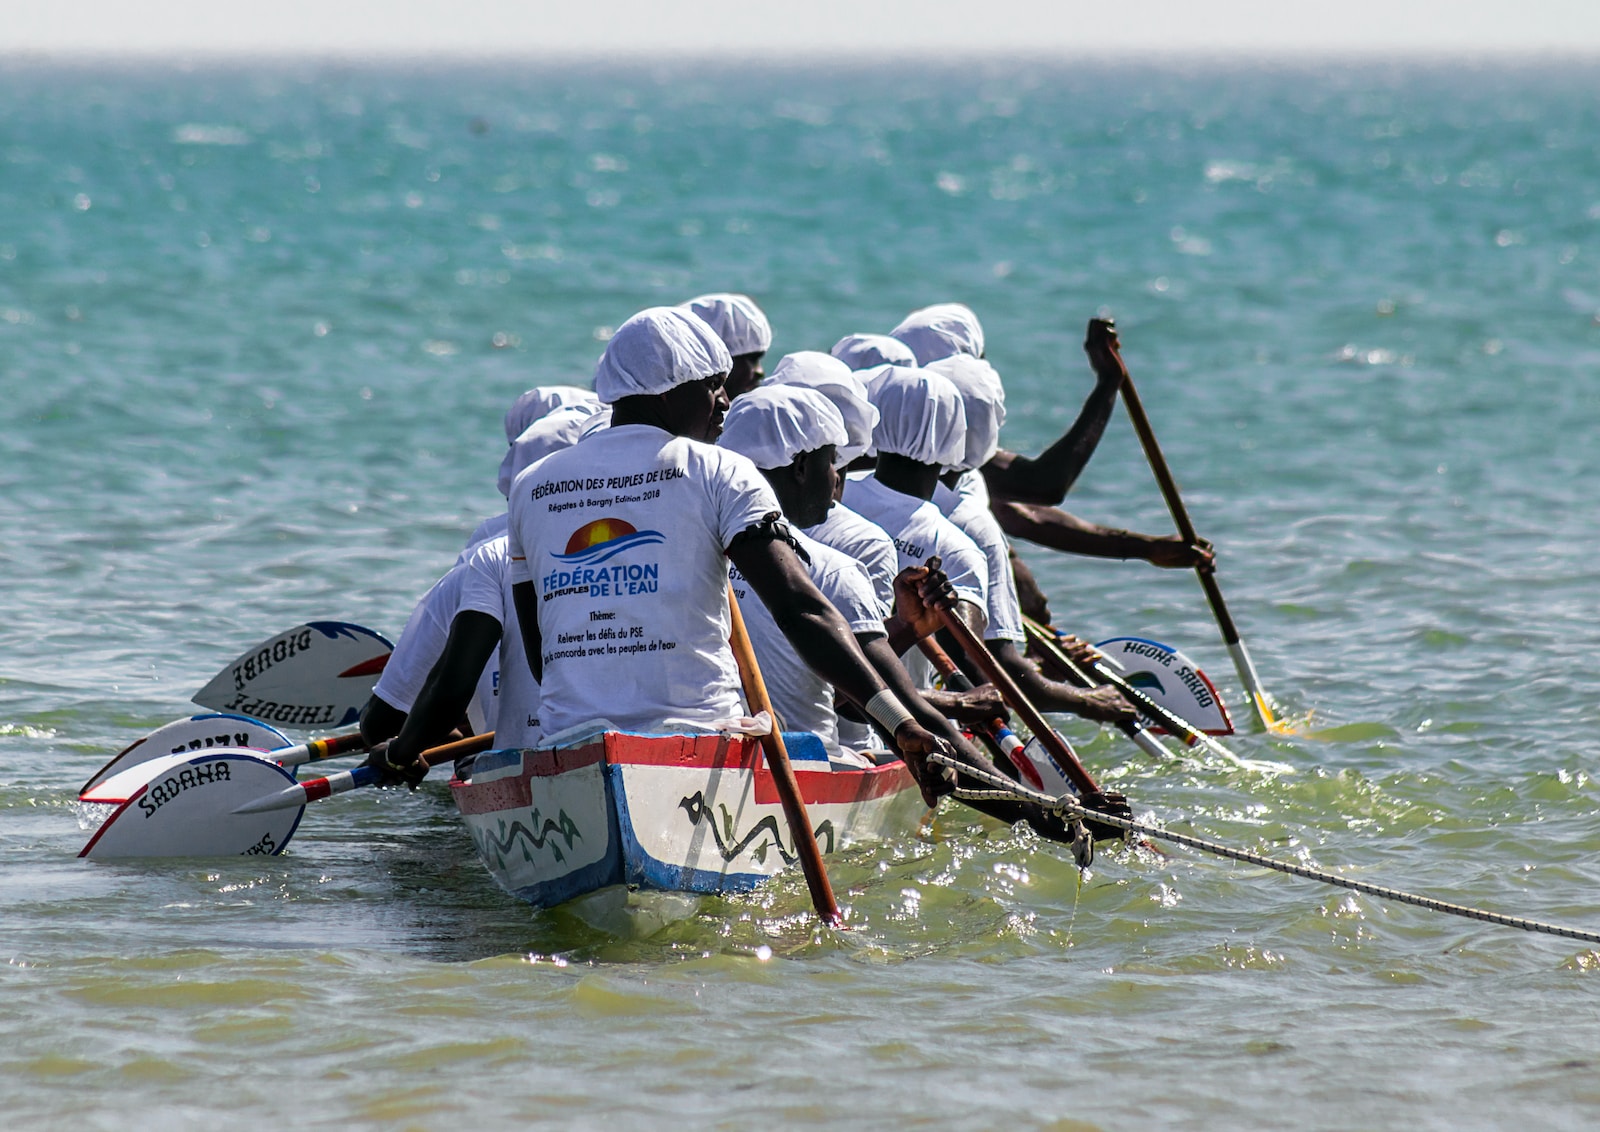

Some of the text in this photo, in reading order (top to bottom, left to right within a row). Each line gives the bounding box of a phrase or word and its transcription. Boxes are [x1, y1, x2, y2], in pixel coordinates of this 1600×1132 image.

[532, 466, 684, 501] FÉDÉRATION DES PEUPLES DE L'EAU
[548, 502, 577, 513] Régates
[586, 496, 613, 508] Bargny
[615, 494, 641, 504] Edition
[643, 489, 660, 501] 2018
[543, 563, 658, 593] FÉDÉRATION
[543, 580, 658, 602] DES PEUPLES DE L'EAU
[589, 610, 616, 622] Thème:
[557, 626, 644, 644] Relever les défis du PSE
[554, 646, 586, 659] concorde
[588, 646, 605, 656] avec
[606, 643, 616, 654] les
[618, 641, 647, 656] peuples
[648, 640, 657, 651] de
[658, 639, 676, 650] l'eau
